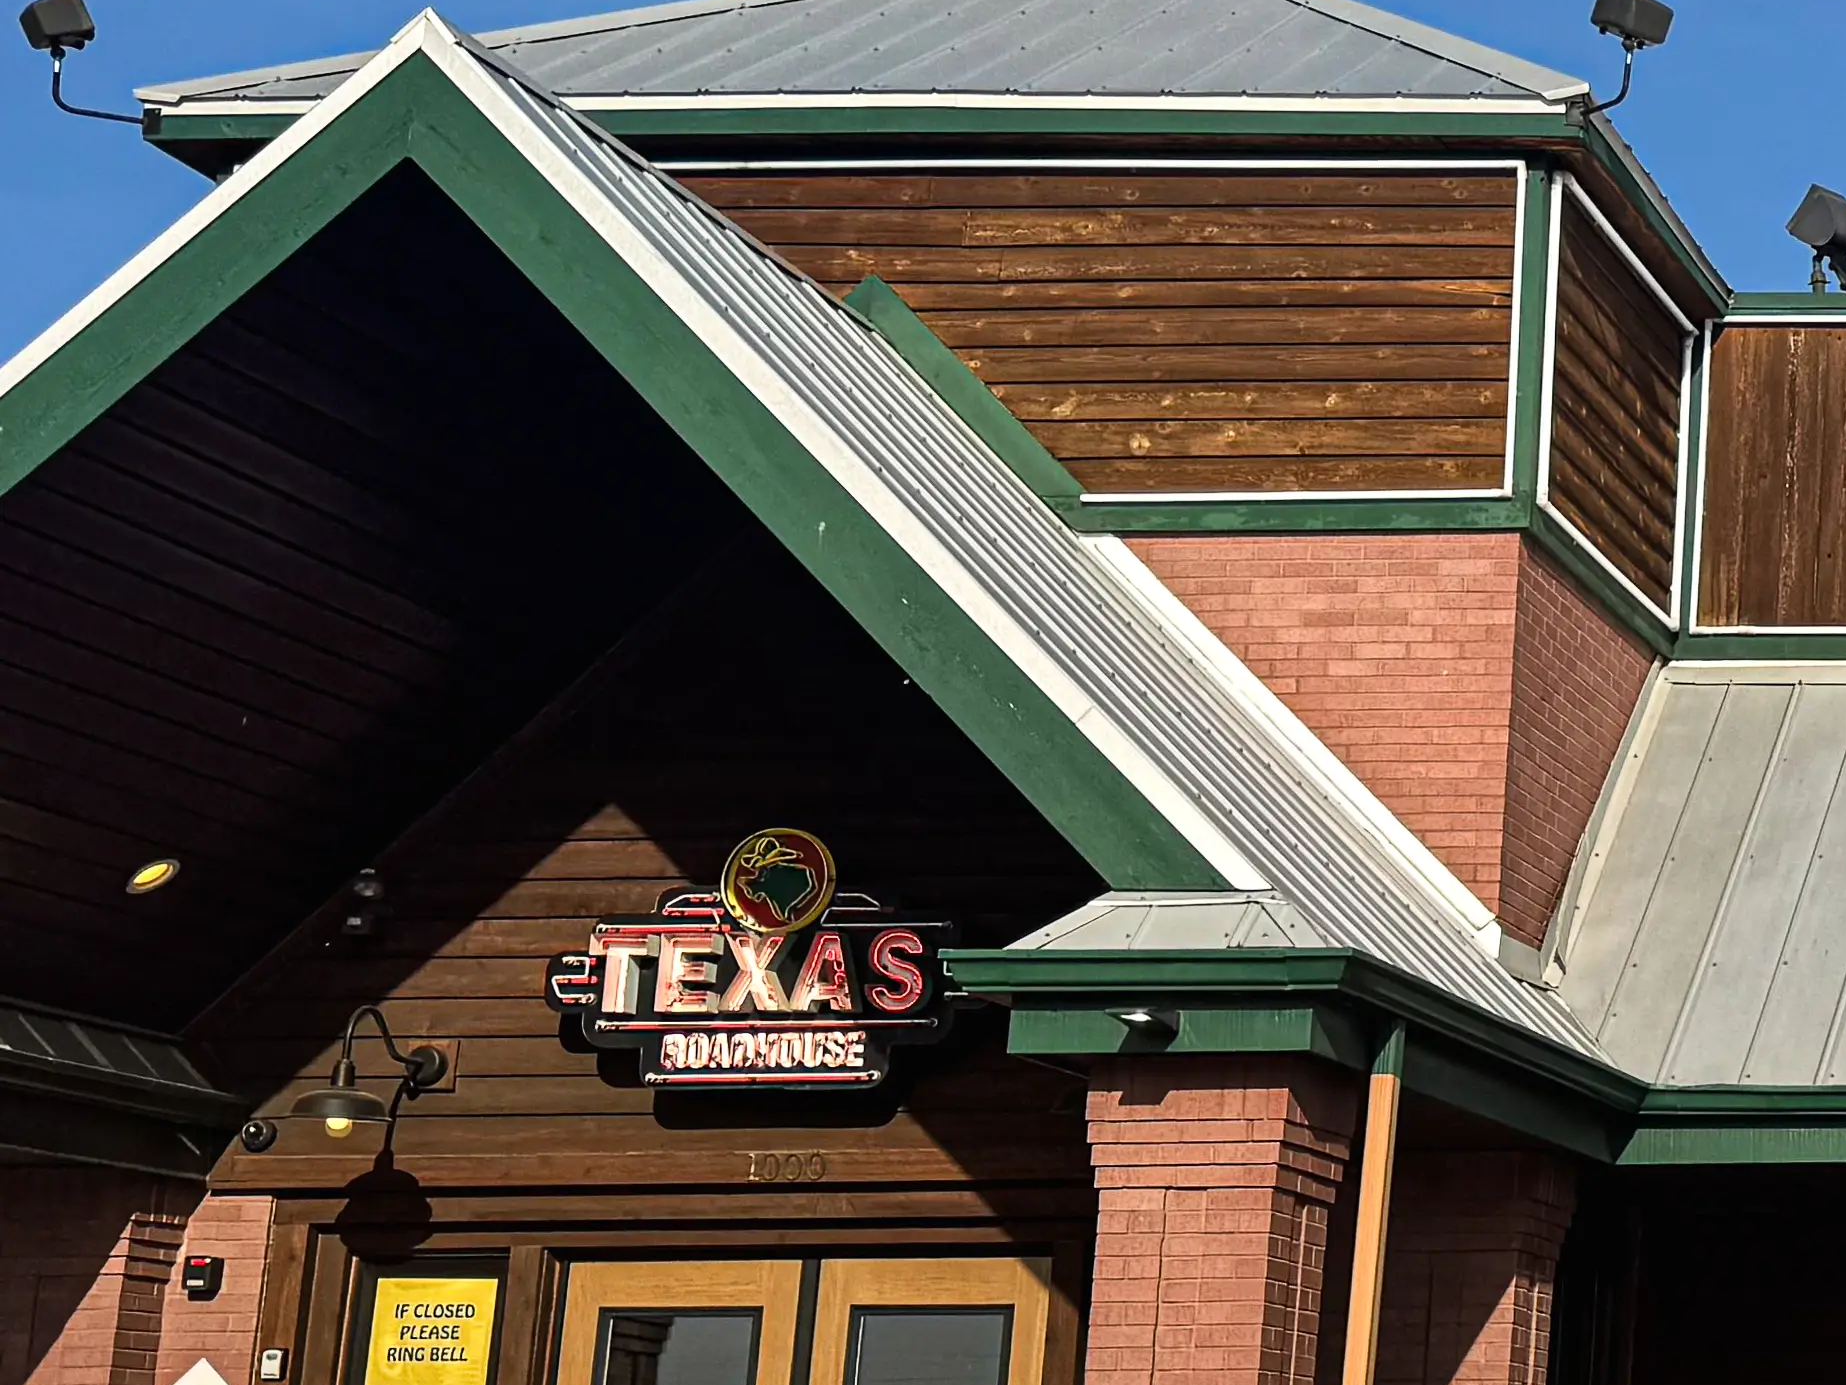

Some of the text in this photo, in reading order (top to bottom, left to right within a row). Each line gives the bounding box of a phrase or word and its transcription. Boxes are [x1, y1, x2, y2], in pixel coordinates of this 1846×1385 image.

[589, 930, 925, 1015] TEXAS
[660, 1030, 867, 1072] ROADHOUSE
[743, 1150, 827, 1183] 1000
[395, 1303, 475, 1319] IF CLOSED
[400, 1325, 460, 1340] PLEASE
[387, 1347, 468, 1362] RING BELL
